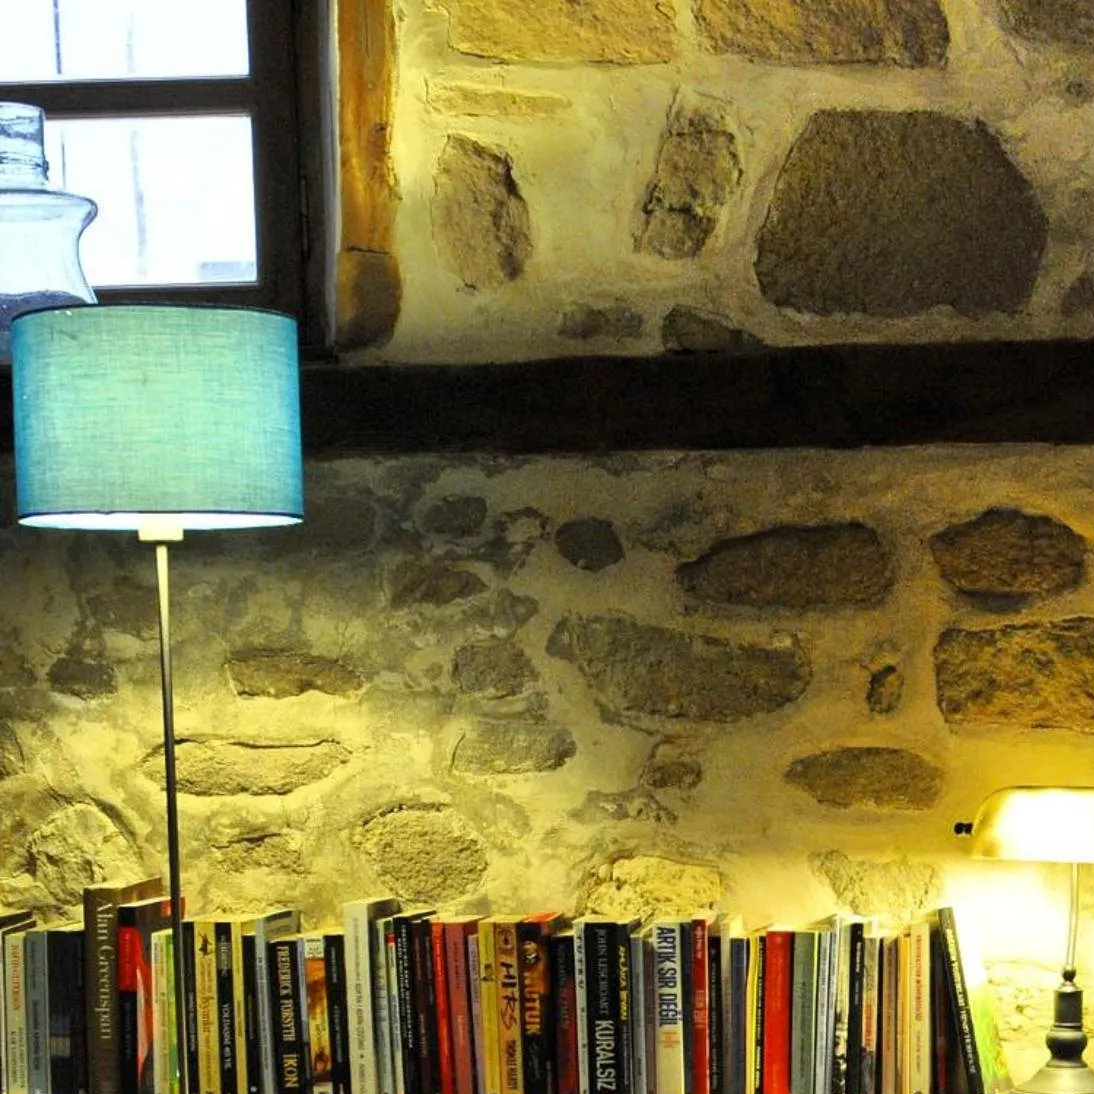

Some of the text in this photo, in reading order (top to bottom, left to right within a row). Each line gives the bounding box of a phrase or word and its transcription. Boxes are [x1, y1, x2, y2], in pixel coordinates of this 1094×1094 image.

[96, 898, 115, 941] Alan
[95, 945, 115, 1040] Greenspan
[276, 946, 293, 997] FREDERICK
[525, 971, 541, 1036] NUTUK
[657, 926, 682, 1029] ARTIK SIR DEĞİL
[280, 999, 297, 1042] FORSYTH
[596, 1020, 616, 1091] KURALSIZ
